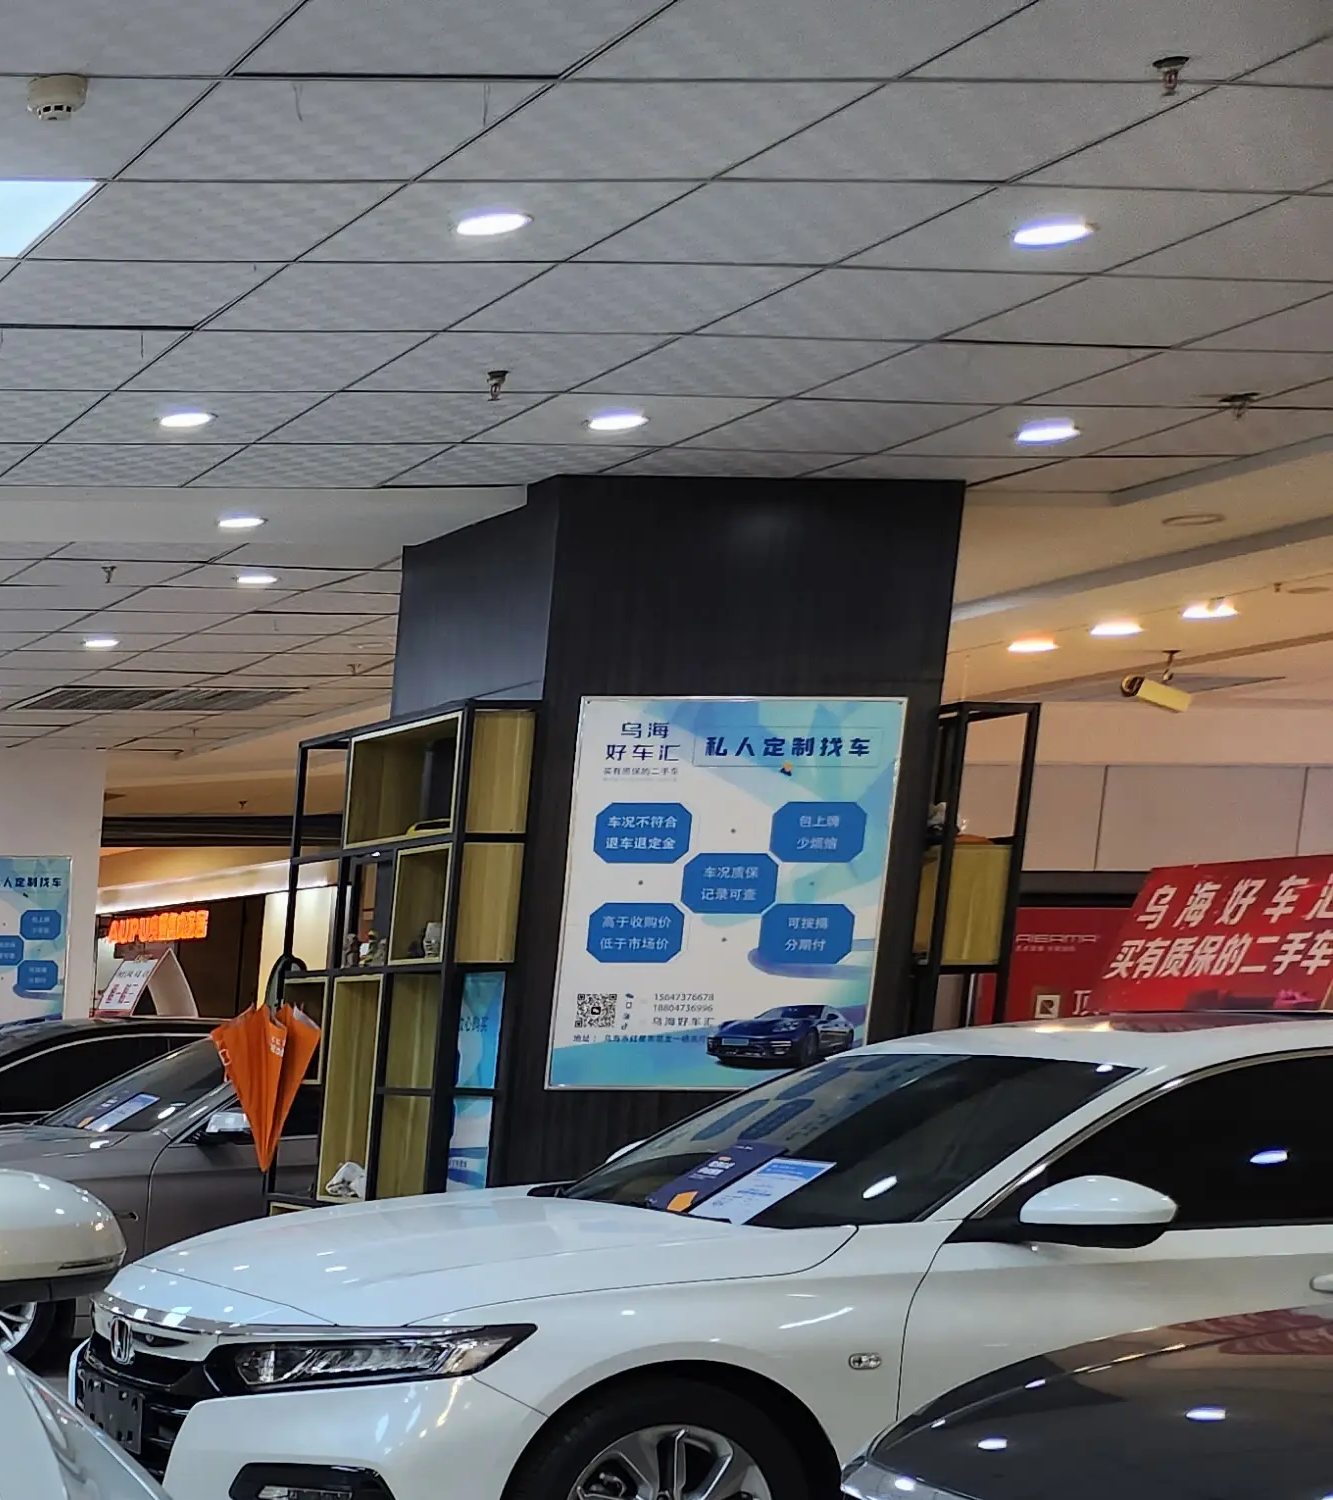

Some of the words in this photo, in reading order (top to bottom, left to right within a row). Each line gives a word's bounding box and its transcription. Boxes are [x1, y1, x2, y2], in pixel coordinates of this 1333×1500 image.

[621, 722, 671, 740] 乌海
[605, 744, 681, 762] 好车汇
[704, 736, 872, 757] 私人定制找车
[607, 815, 678, 828] 车况不符合
[605, 837, 676, 850] 退车退定金
[703, 866, 759, 878] 车况质保
[701, 888, 757, 901] 记录可查
[601, 915, 672, 929] 高于收购价
[599, 937, 670, 951] 低于市场价
[1102, 929, 1333, 980] 买有质保的二手车
